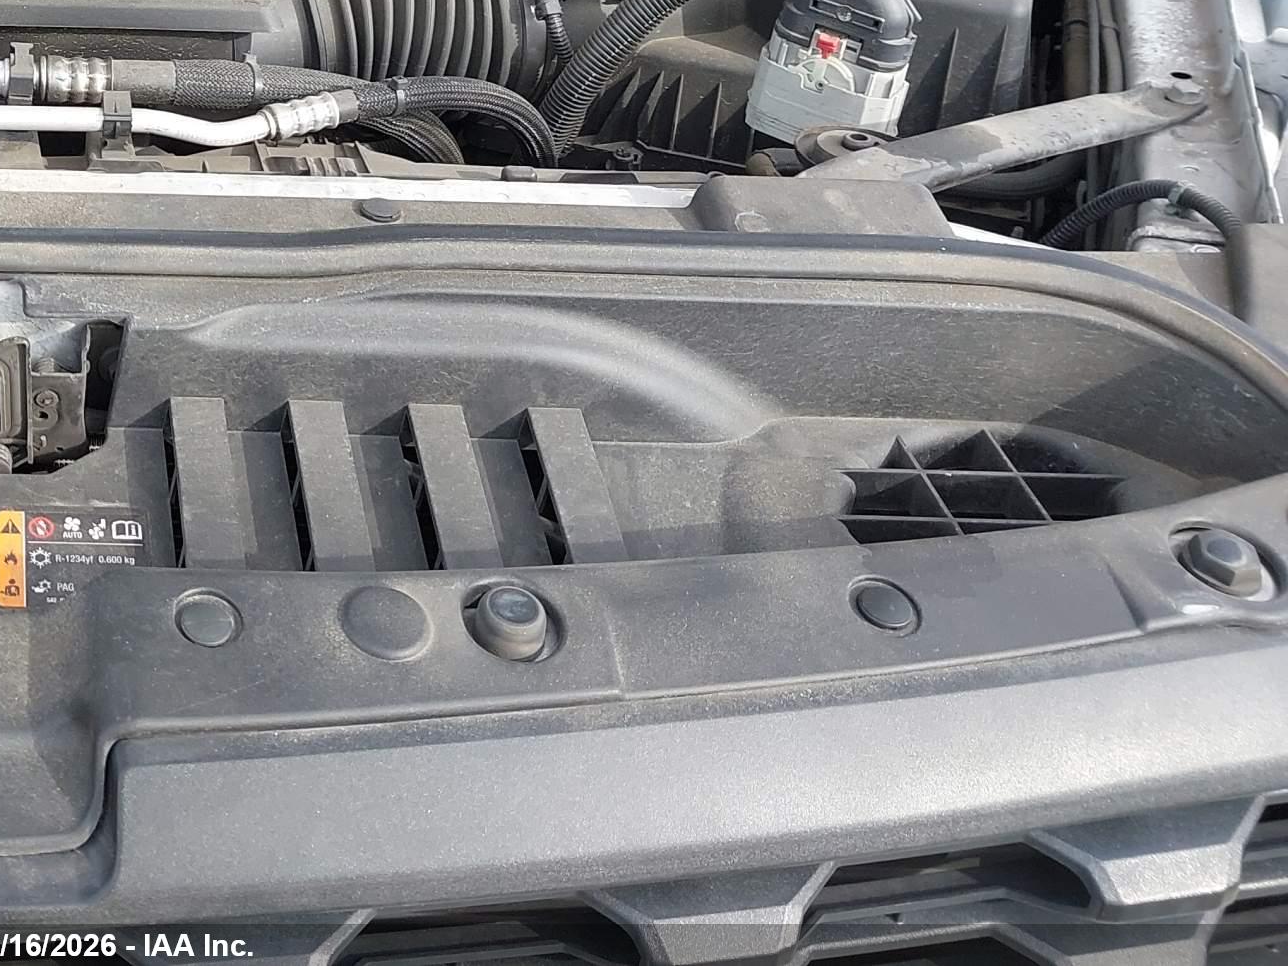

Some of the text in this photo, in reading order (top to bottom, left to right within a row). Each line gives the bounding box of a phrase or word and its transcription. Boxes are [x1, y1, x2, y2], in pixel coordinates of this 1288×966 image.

[55, 555, 135, 565] R-1234yf 0.600 kg
[57, 582, 75, 591] PAG
